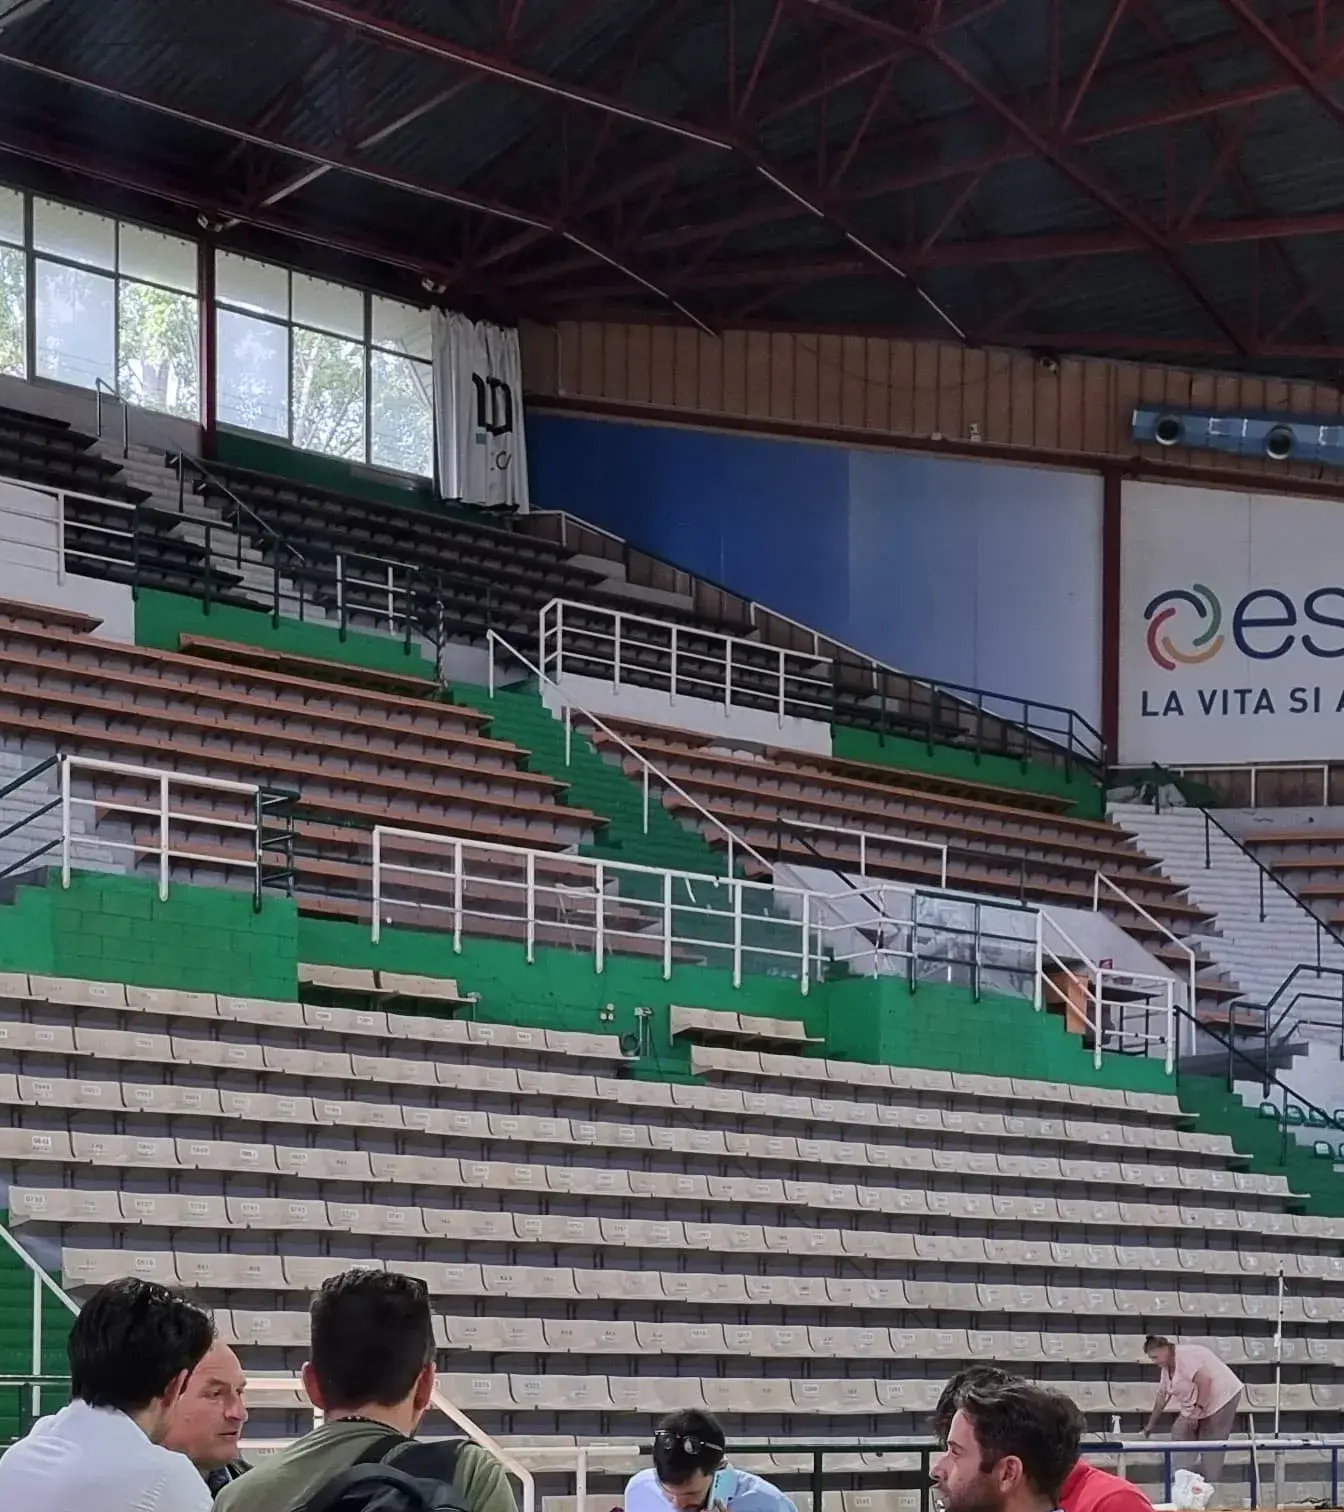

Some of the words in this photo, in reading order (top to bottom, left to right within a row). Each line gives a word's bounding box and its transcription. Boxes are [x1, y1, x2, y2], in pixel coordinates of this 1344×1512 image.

[1141, 690, 1185, 717] LA
[1197, 688, 1276, 716] VITA
[1289, 686, 1321, 714] SI
